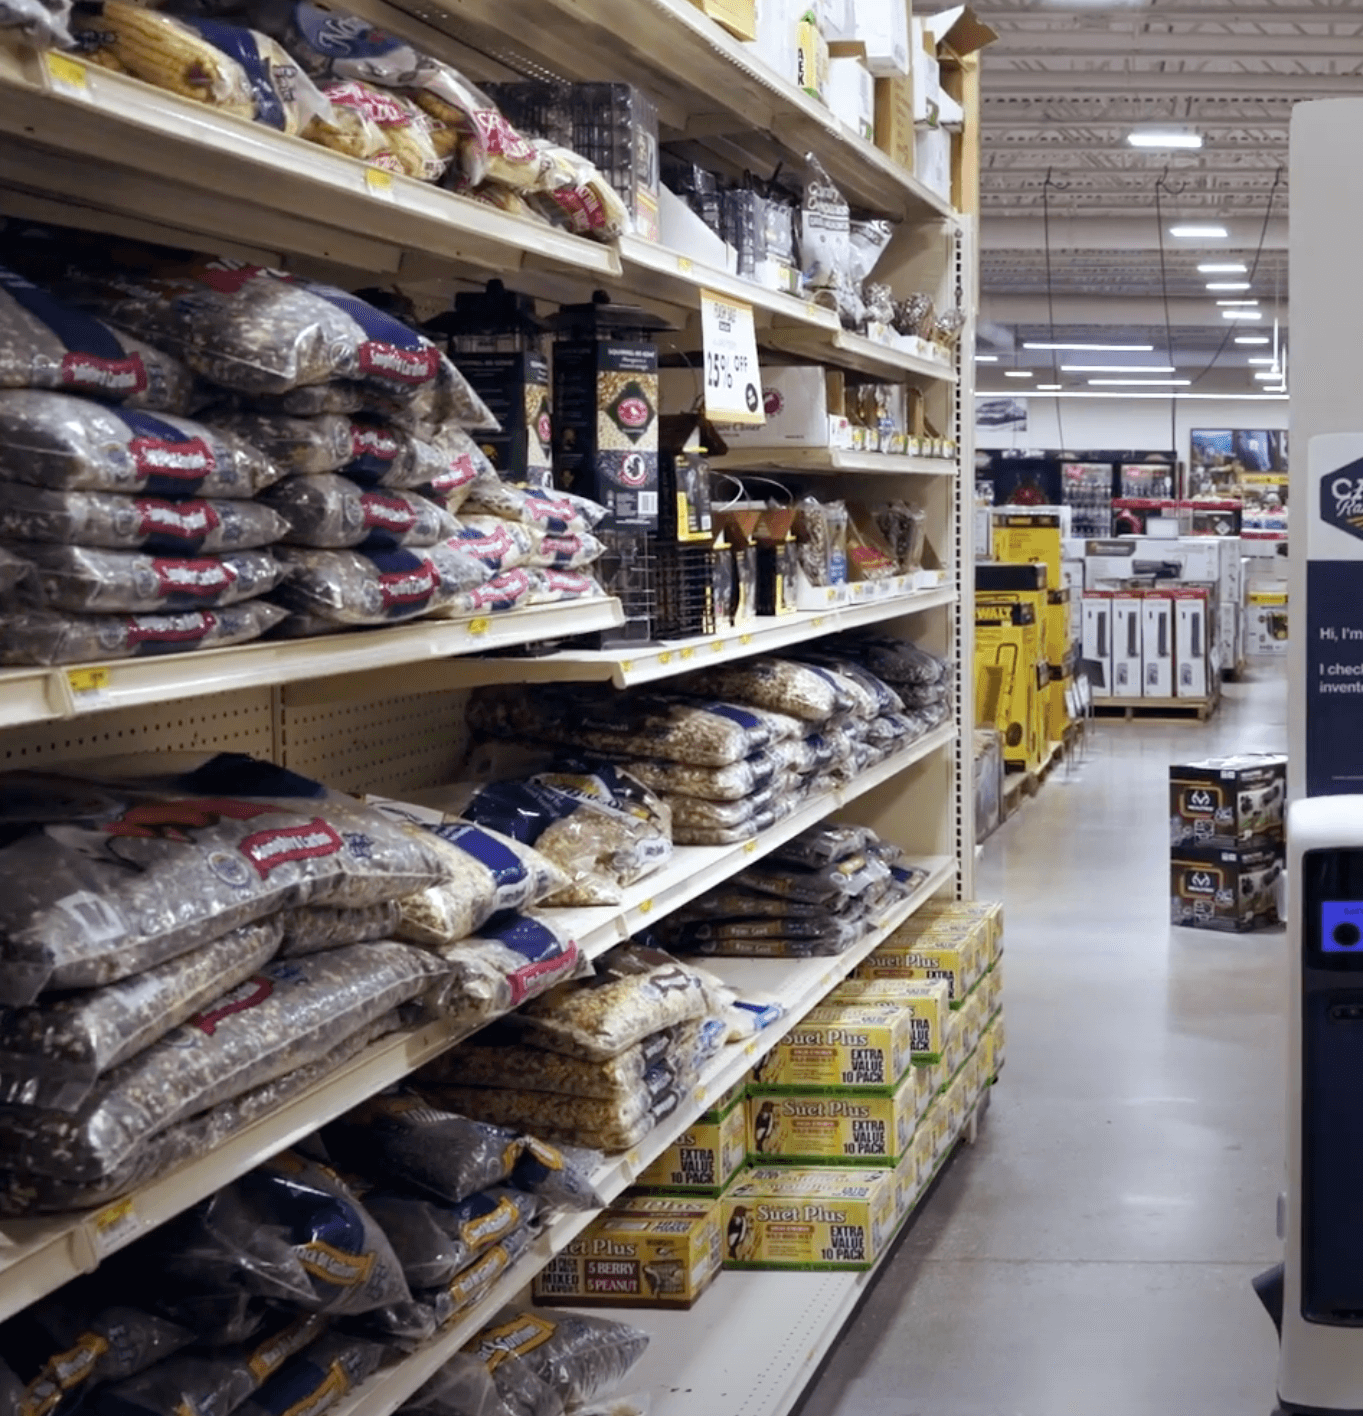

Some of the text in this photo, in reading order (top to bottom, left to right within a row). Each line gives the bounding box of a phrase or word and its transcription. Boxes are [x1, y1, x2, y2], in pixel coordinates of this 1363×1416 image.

[707, 350, 748, 390] 25% OFF
[975, 604, 1012, 619] WALT
[1319, 627, 1339, 643] Hi,
[1341, 627, 1363, 640] I'm
[1319, 663, 1324, 675] I
[868, 954, 940, 968] Suet Plus
[926, 971, 954, 979] EXTRA
[911, 1019, 930, 1030] TRA
[784, 1029, 868, 1046] Suet Plus
[911, 1029, 930, 1041] LUE
[911, 1040, 930, 1052] ACK
[851, 1048, 884, 1060] EXTRA
[852, 1059, 885, 1071] VALUE
[842, 1071, 884, 1083] 10 PACK
[782, 1100, 870, 1118] Suet Plus
[852, 1120, 885, 1131] EXTRA
[853, 1131, 885, 1143] VALUE
[680, 1149, 714, 1160] EXTRA
[843, 1143, 886, 1155] 10 PACK
[681, 1159, 714, 1172] VALUE
[671, 1171, 715, 1184] 10 PACK
[756, 1204, 847, 1223] Suet Plus
[830, 1225, 864, 1237] EXTRA
[560, 1239, 636, 1256] uet Plus
[831, 1236, 864, 1249] VALUE
[821, 1248, 866, 1261] 10 PACK
[588, 1262, 635, 1275] 5 BERRY
[542, 1273, 578, 1285] MIXED
[587, 1279, 638, 1292] 5 PEANUT
